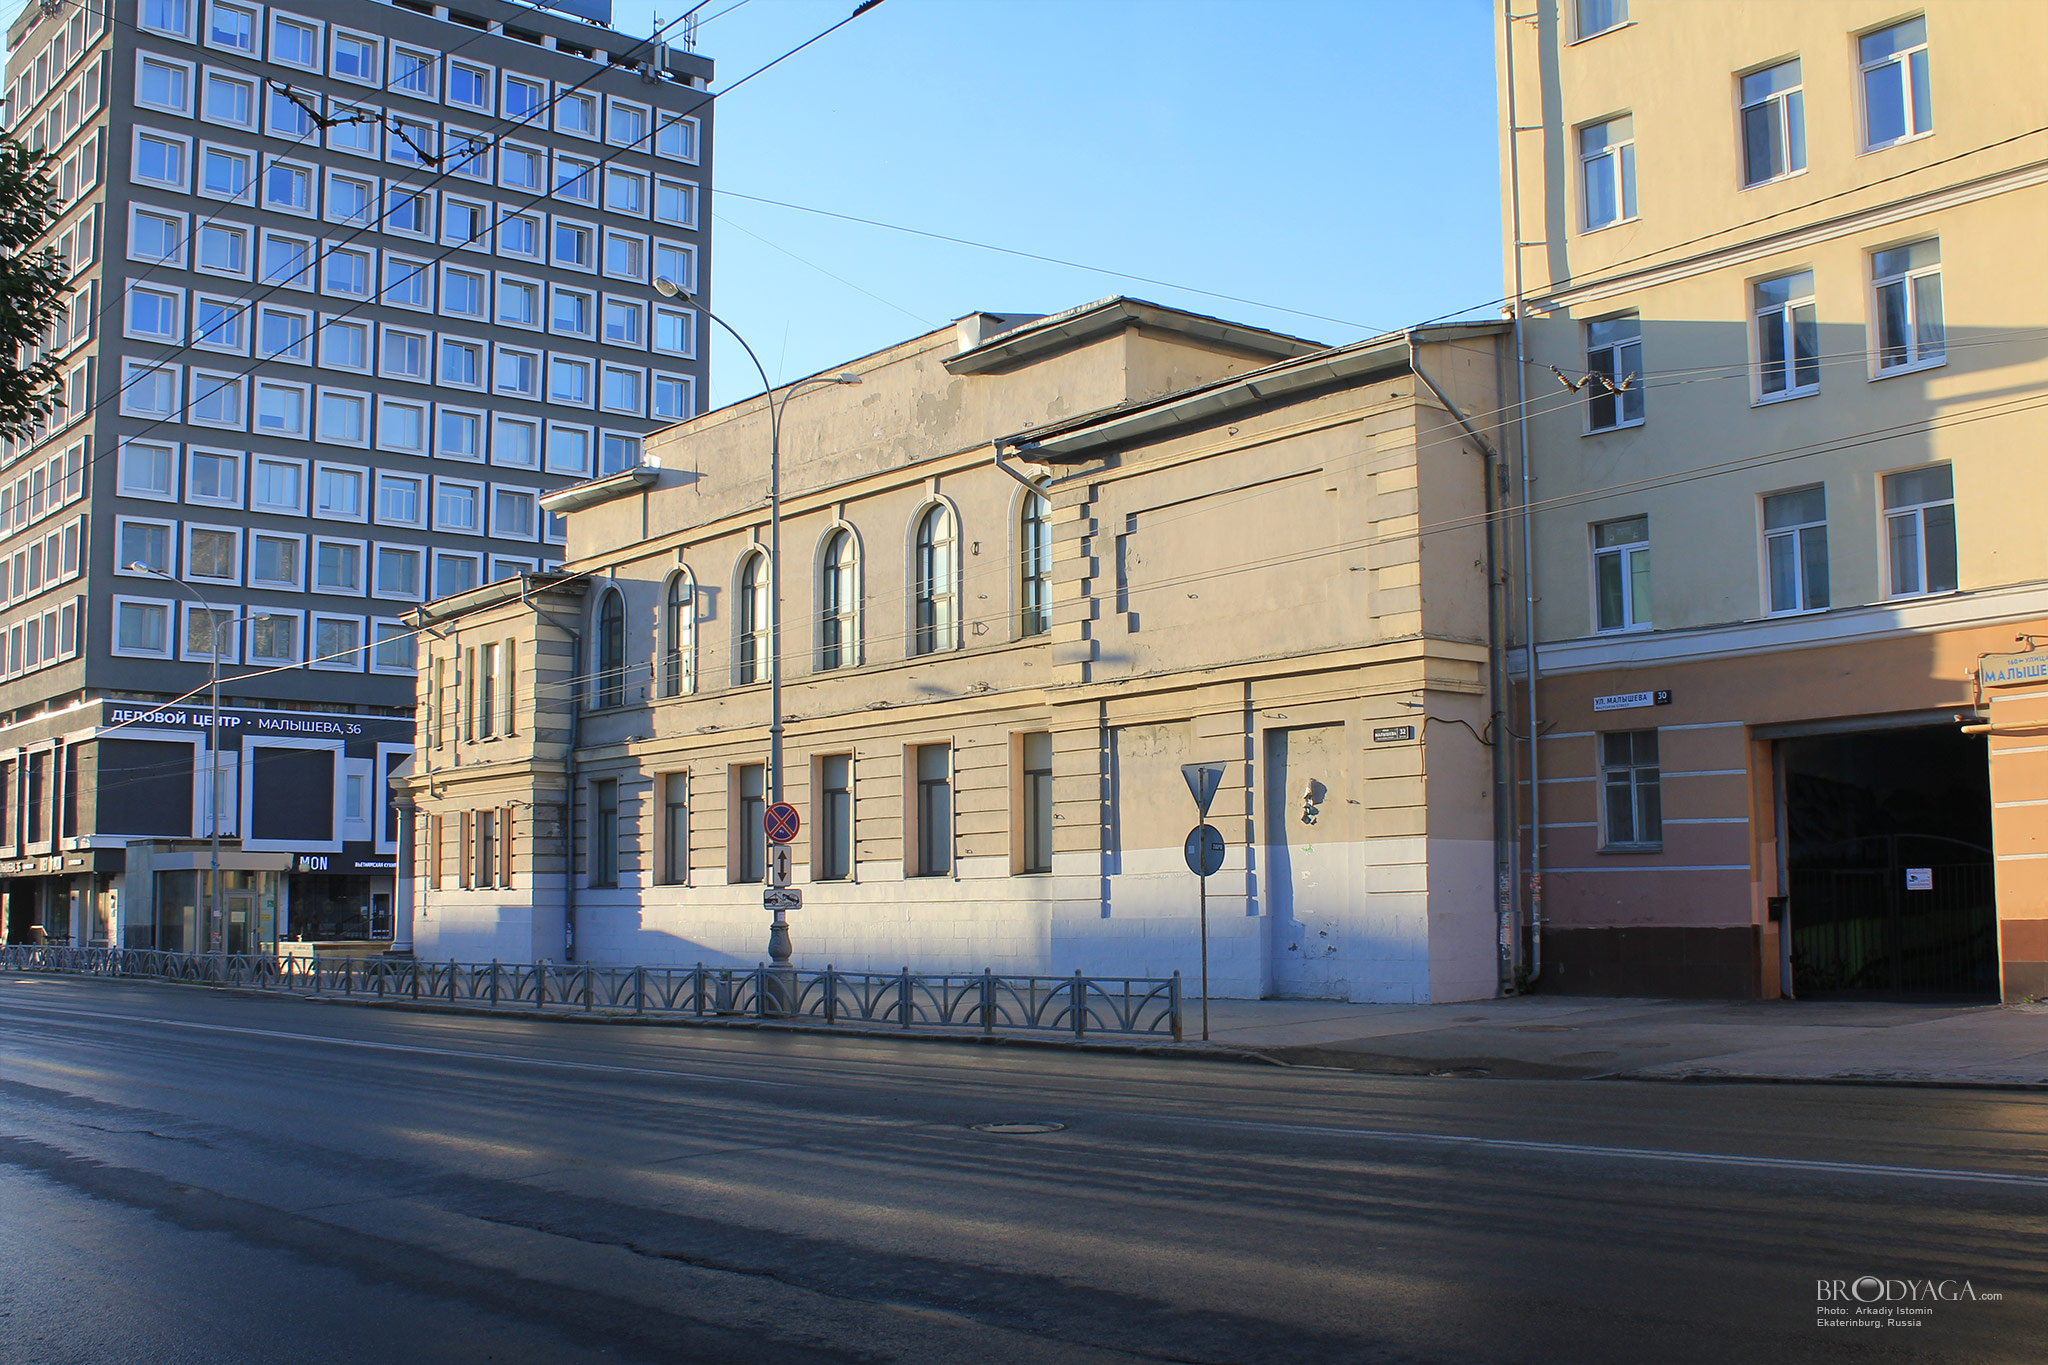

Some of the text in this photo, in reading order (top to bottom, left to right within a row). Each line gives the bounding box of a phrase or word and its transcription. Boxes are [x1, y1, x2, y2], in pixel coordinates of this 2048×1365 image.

[1984, 664, 2048, 682] МАЛЫШЕ
[1595, 697, 1606, 706] УЛ.
[1607, 694, 1648, 704] МАЛЫШЕВА
[1657, 692, 1667, 700] 30
[111, 709, 187, 724] ДЕЛОВОЙ
[258, 718, 344, 735] МАЛЫШЕВА,
[346, 723, 362, 735] 36
